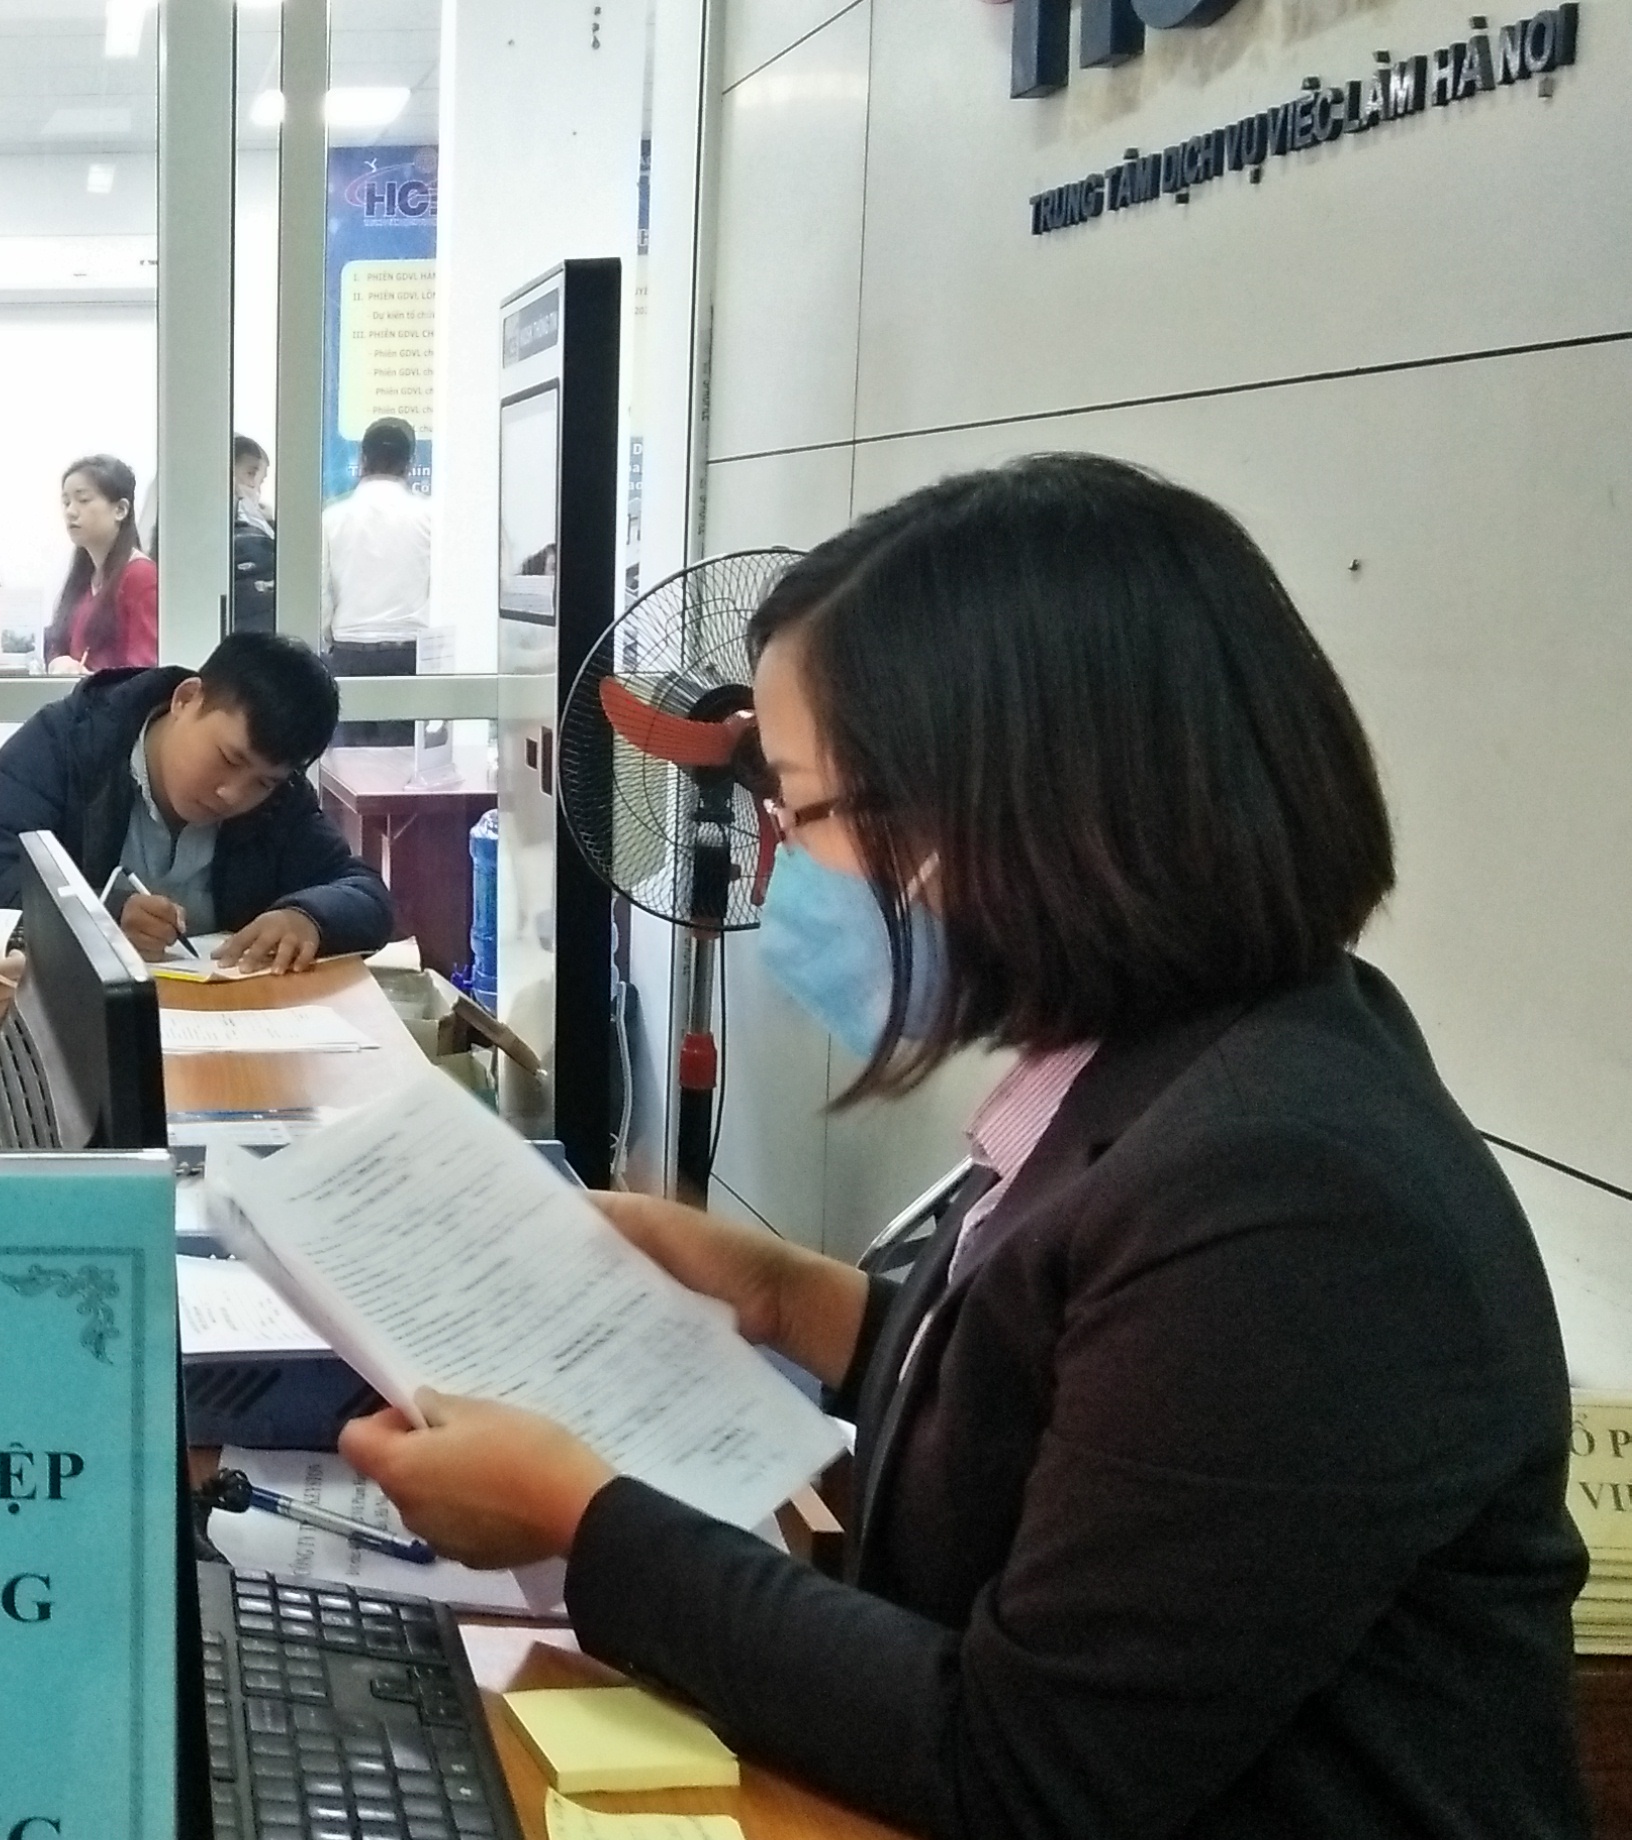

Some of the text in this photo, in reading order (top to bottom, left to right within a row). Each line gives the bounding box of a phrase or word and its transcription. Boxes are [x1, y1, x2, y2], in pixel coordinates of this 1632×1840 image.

[1030, 173, 1105, 235] TRUNG
[1163, 128, 1225, 204] DỊCH
[1225, 112, 1269, 184] VỤ
[1429, 14, 1495, 107] HÀ
